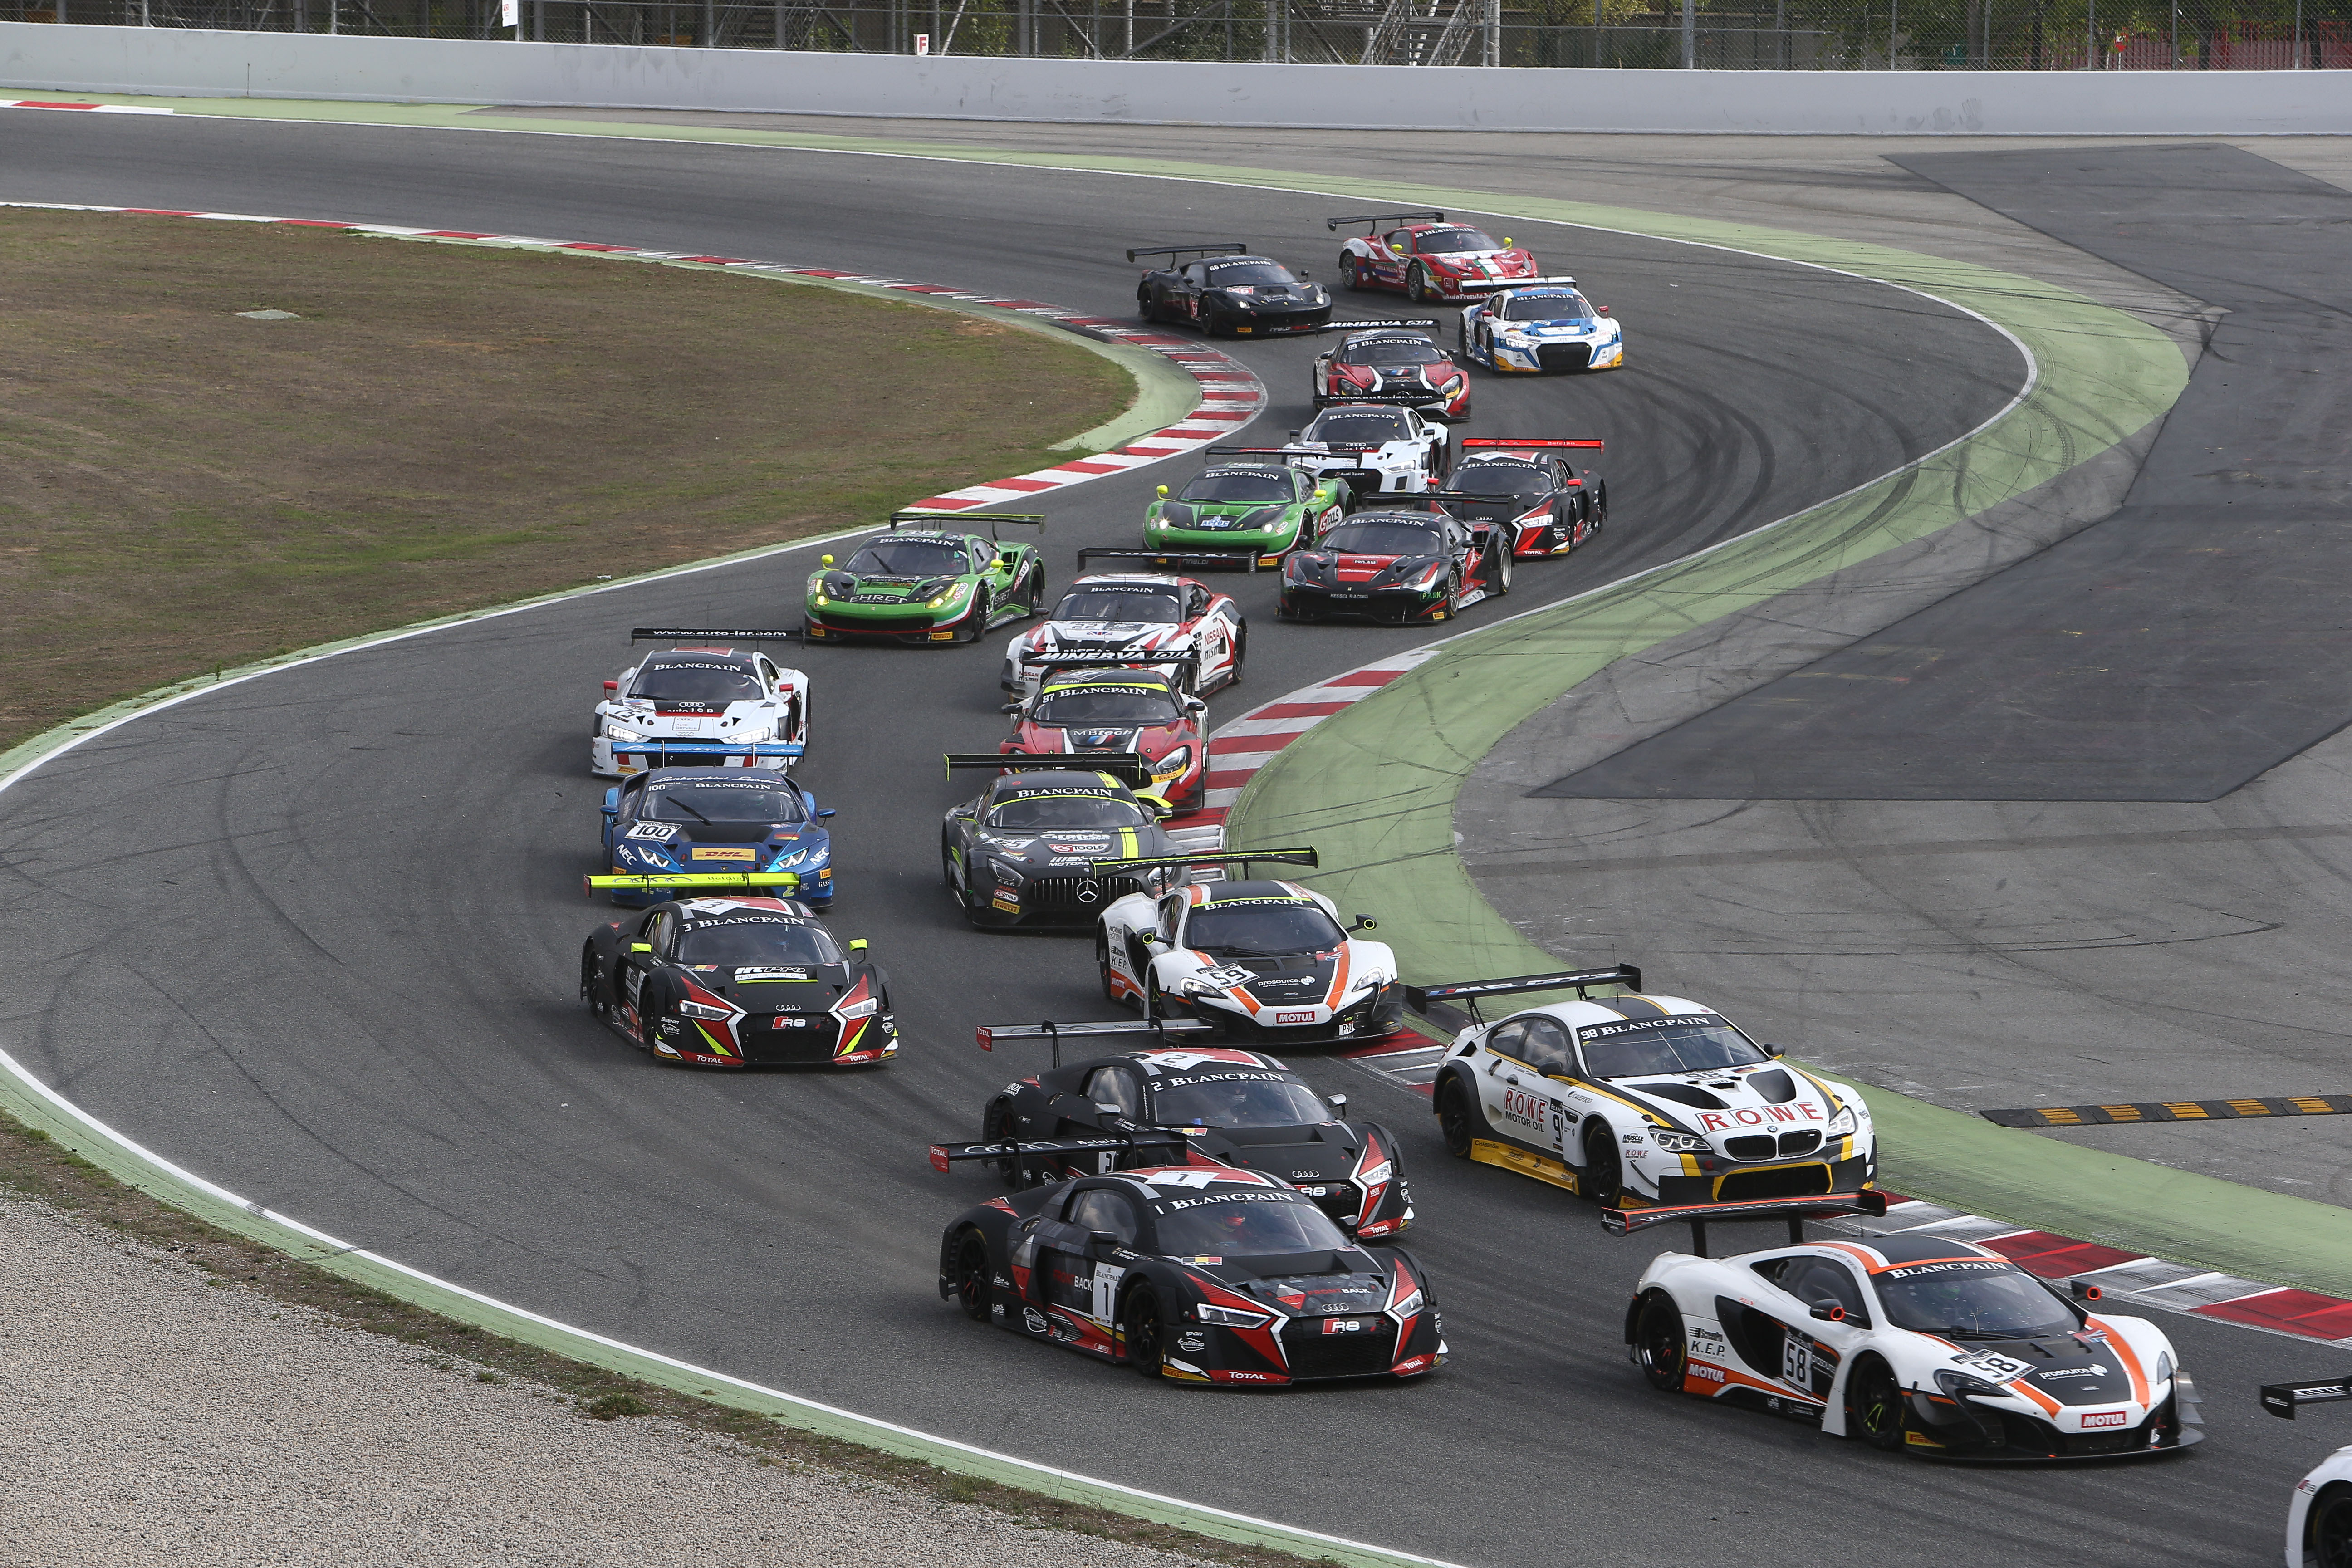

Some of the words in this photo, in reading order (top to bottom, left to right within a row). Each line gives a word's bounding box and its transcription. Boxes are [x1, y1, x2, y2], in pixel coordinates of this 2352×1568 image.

[919, 37, 926, 52] F
[1220, 260, 1271, 269] BLANCPAIN
[1205, 471, 1279, 480] BLANCPAIN
[1351, 519, 1426, 528] BLANCPAIN
[879, 537, 955, 547] BLANCPAIN
[849, 594, 907, 604] EHRET
[1204, 626, 1225, 646] NISSAN
[654, 662, 741, 672] BLANCPAIN
[1043, 693, 1055, 704] 87
[1059, 687, 1147, 697] BLANCPAIN
[1158, 772, 1178, 781] PIRELLI
[1017, 788, 1112, 798] BLANCPAIN
[637, 825, 672, 838] 100
[617, 844, 638, 865] NEC
[809, 847, 830, 866] NEC
[1204, 899, 1303, 911] BLANCPAIN
[682, 923, 692, 932] 3
[696, 917, 805, 928] BLANCPAIN
[1111, 956, 1127, 970] K.E.P.
[1209, 970, 1248, 985] 59
[781, 1018, 806, 1028] R8
[1278, 1012, 1314, 1022] MOTUL
[976, 1027, 990, 1038] TOTAL
[1581, 1029, 1598, 1039] 98
[1598, 1016, 1710, 1036] BLANCPAIN
[696, 1055, 723, 1064] TOTAL
[1151, 1082, 1164, 1092] 2
[1168, 1073, 1285, 1087] BLANCPAIN
[1505, 1088, 1547, 1123] ROWE
[1506, 1111, 1531, 1128] MOTOR
[1533, 1121, 1545, 1133] OIL
[1701, 1103, 1823, 1131] ROWE
[1553, 1114, 1563, 1143] 9
[931, 1146, 946, 1158] TOTAL
[1169, 1192, 1294, 1210] BLANCPAIN
[1368, 1225, 1389, 1234] TOTAL
[1887, 1261, 2009, 1280] BLANCPAIN
[1103, 1281, 1109, 1316] 1
[1331, 1320, 1361, 1332] R8
[1690, 1340, 1725, 1357] K.E.P.
[1403, 1358, 1423, 1370] TOTAL
[1786, 1342, 1807, 1383] 58
[1970, 1357, 2019, 1378] 58
[1228, 1371, 1267, 1380] TOTAL
[1688, 1363, 1725, 1382] MOTUL
[2084, 1413, 2125, 1426] MOTUL
